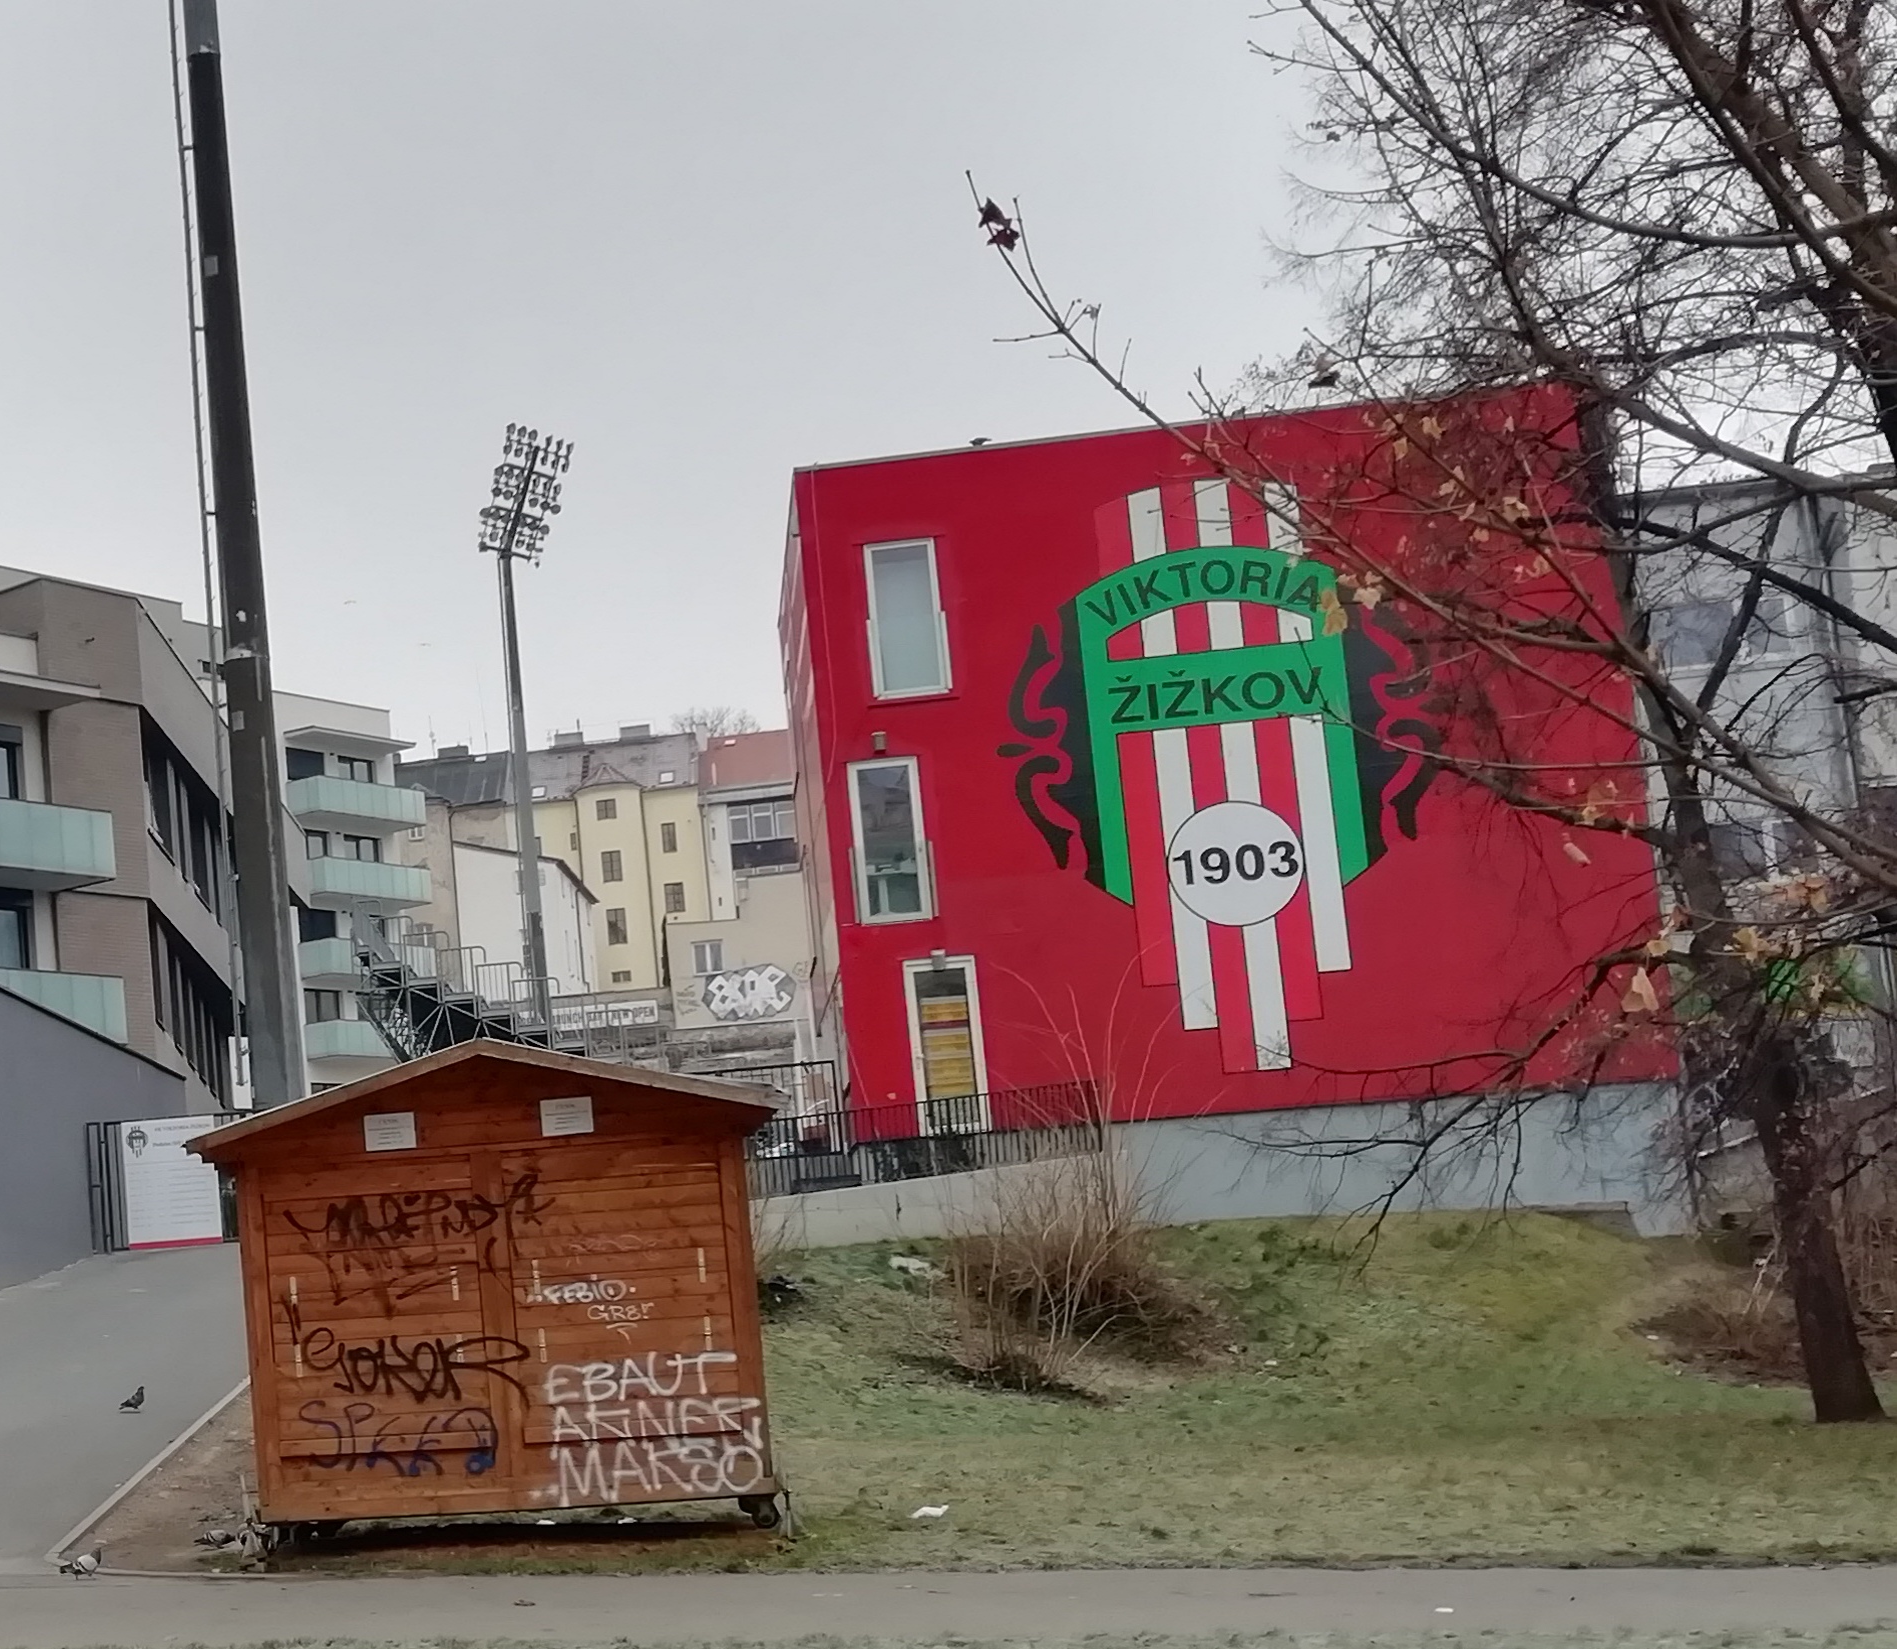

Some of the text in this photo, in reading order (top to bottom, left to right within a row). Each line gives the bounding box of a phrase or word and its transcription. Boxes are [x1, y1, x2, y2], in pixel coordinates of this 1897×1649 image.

[1084, 560, 1319, 626] VIKTORIA
[1108, 669, 1322, 724] ŽIŽKOV
[1172, 840, 1299, 885] 1903
